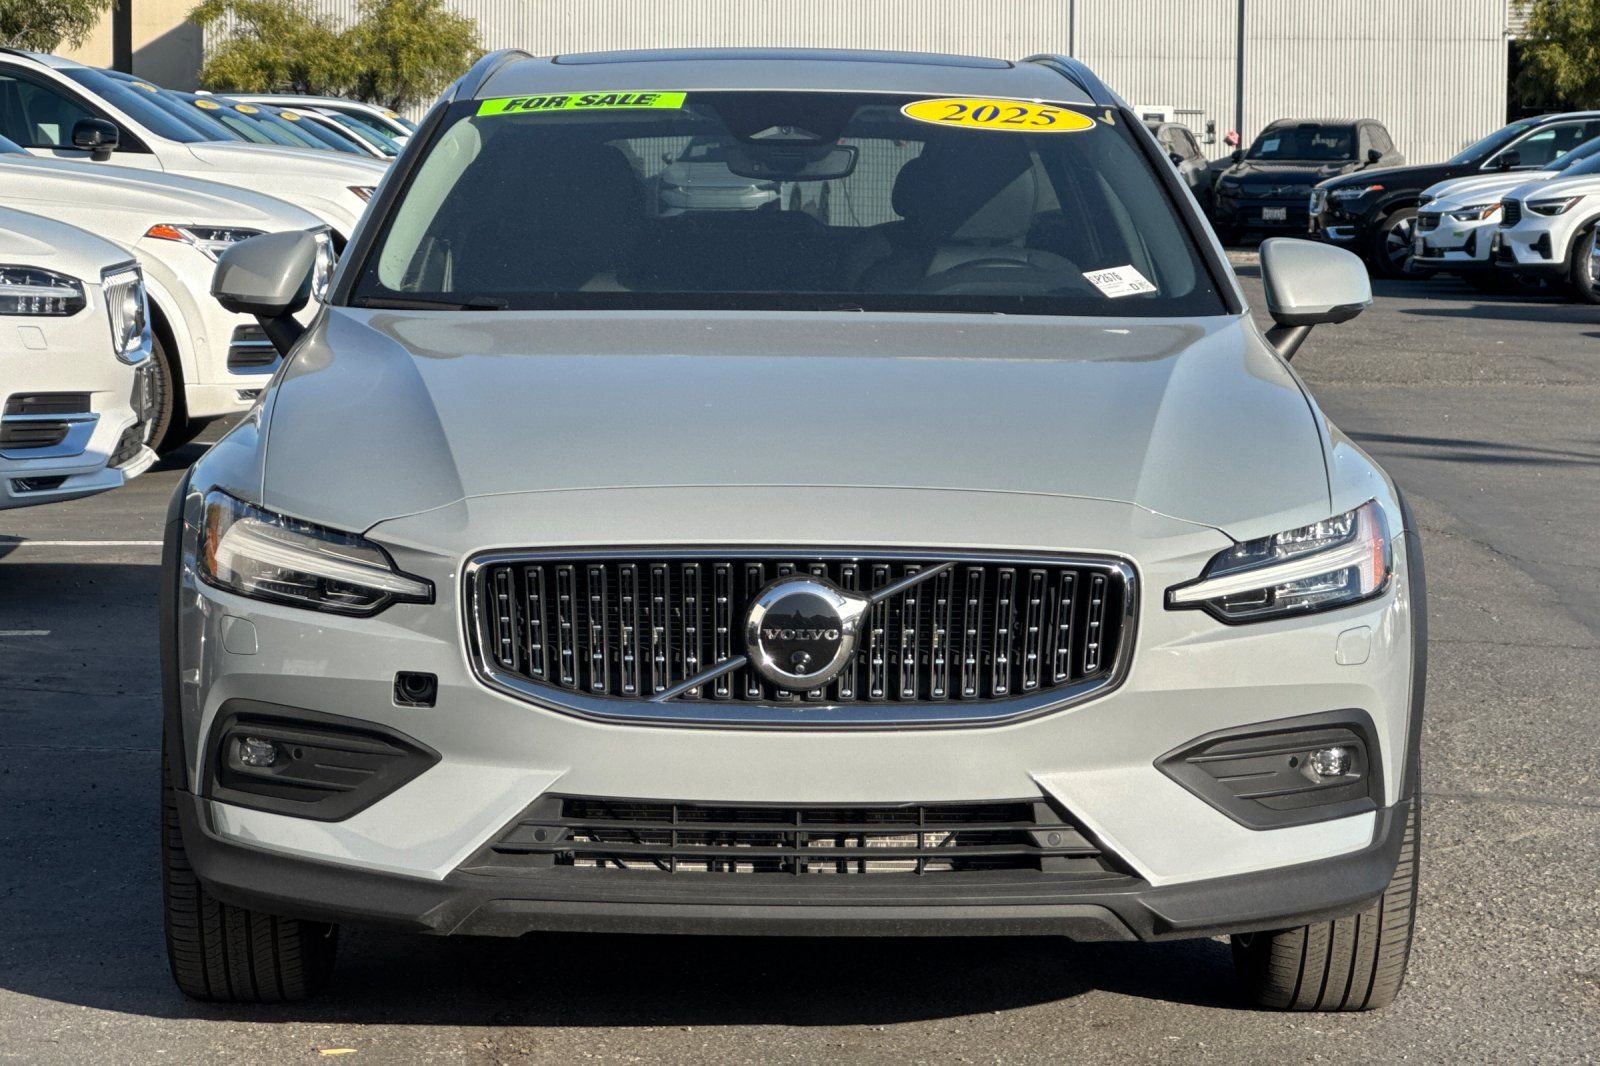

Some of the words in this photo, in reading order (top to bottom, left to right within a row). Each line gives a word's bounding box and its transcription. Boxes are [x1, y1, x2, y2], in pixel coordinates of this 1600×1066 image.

[502, 96, 571, 110] FOR
[574, 93, 661, 107] SALE
[939, 103, 1060, 126] 2025
[763, 629, 839, 640] VOLVO
